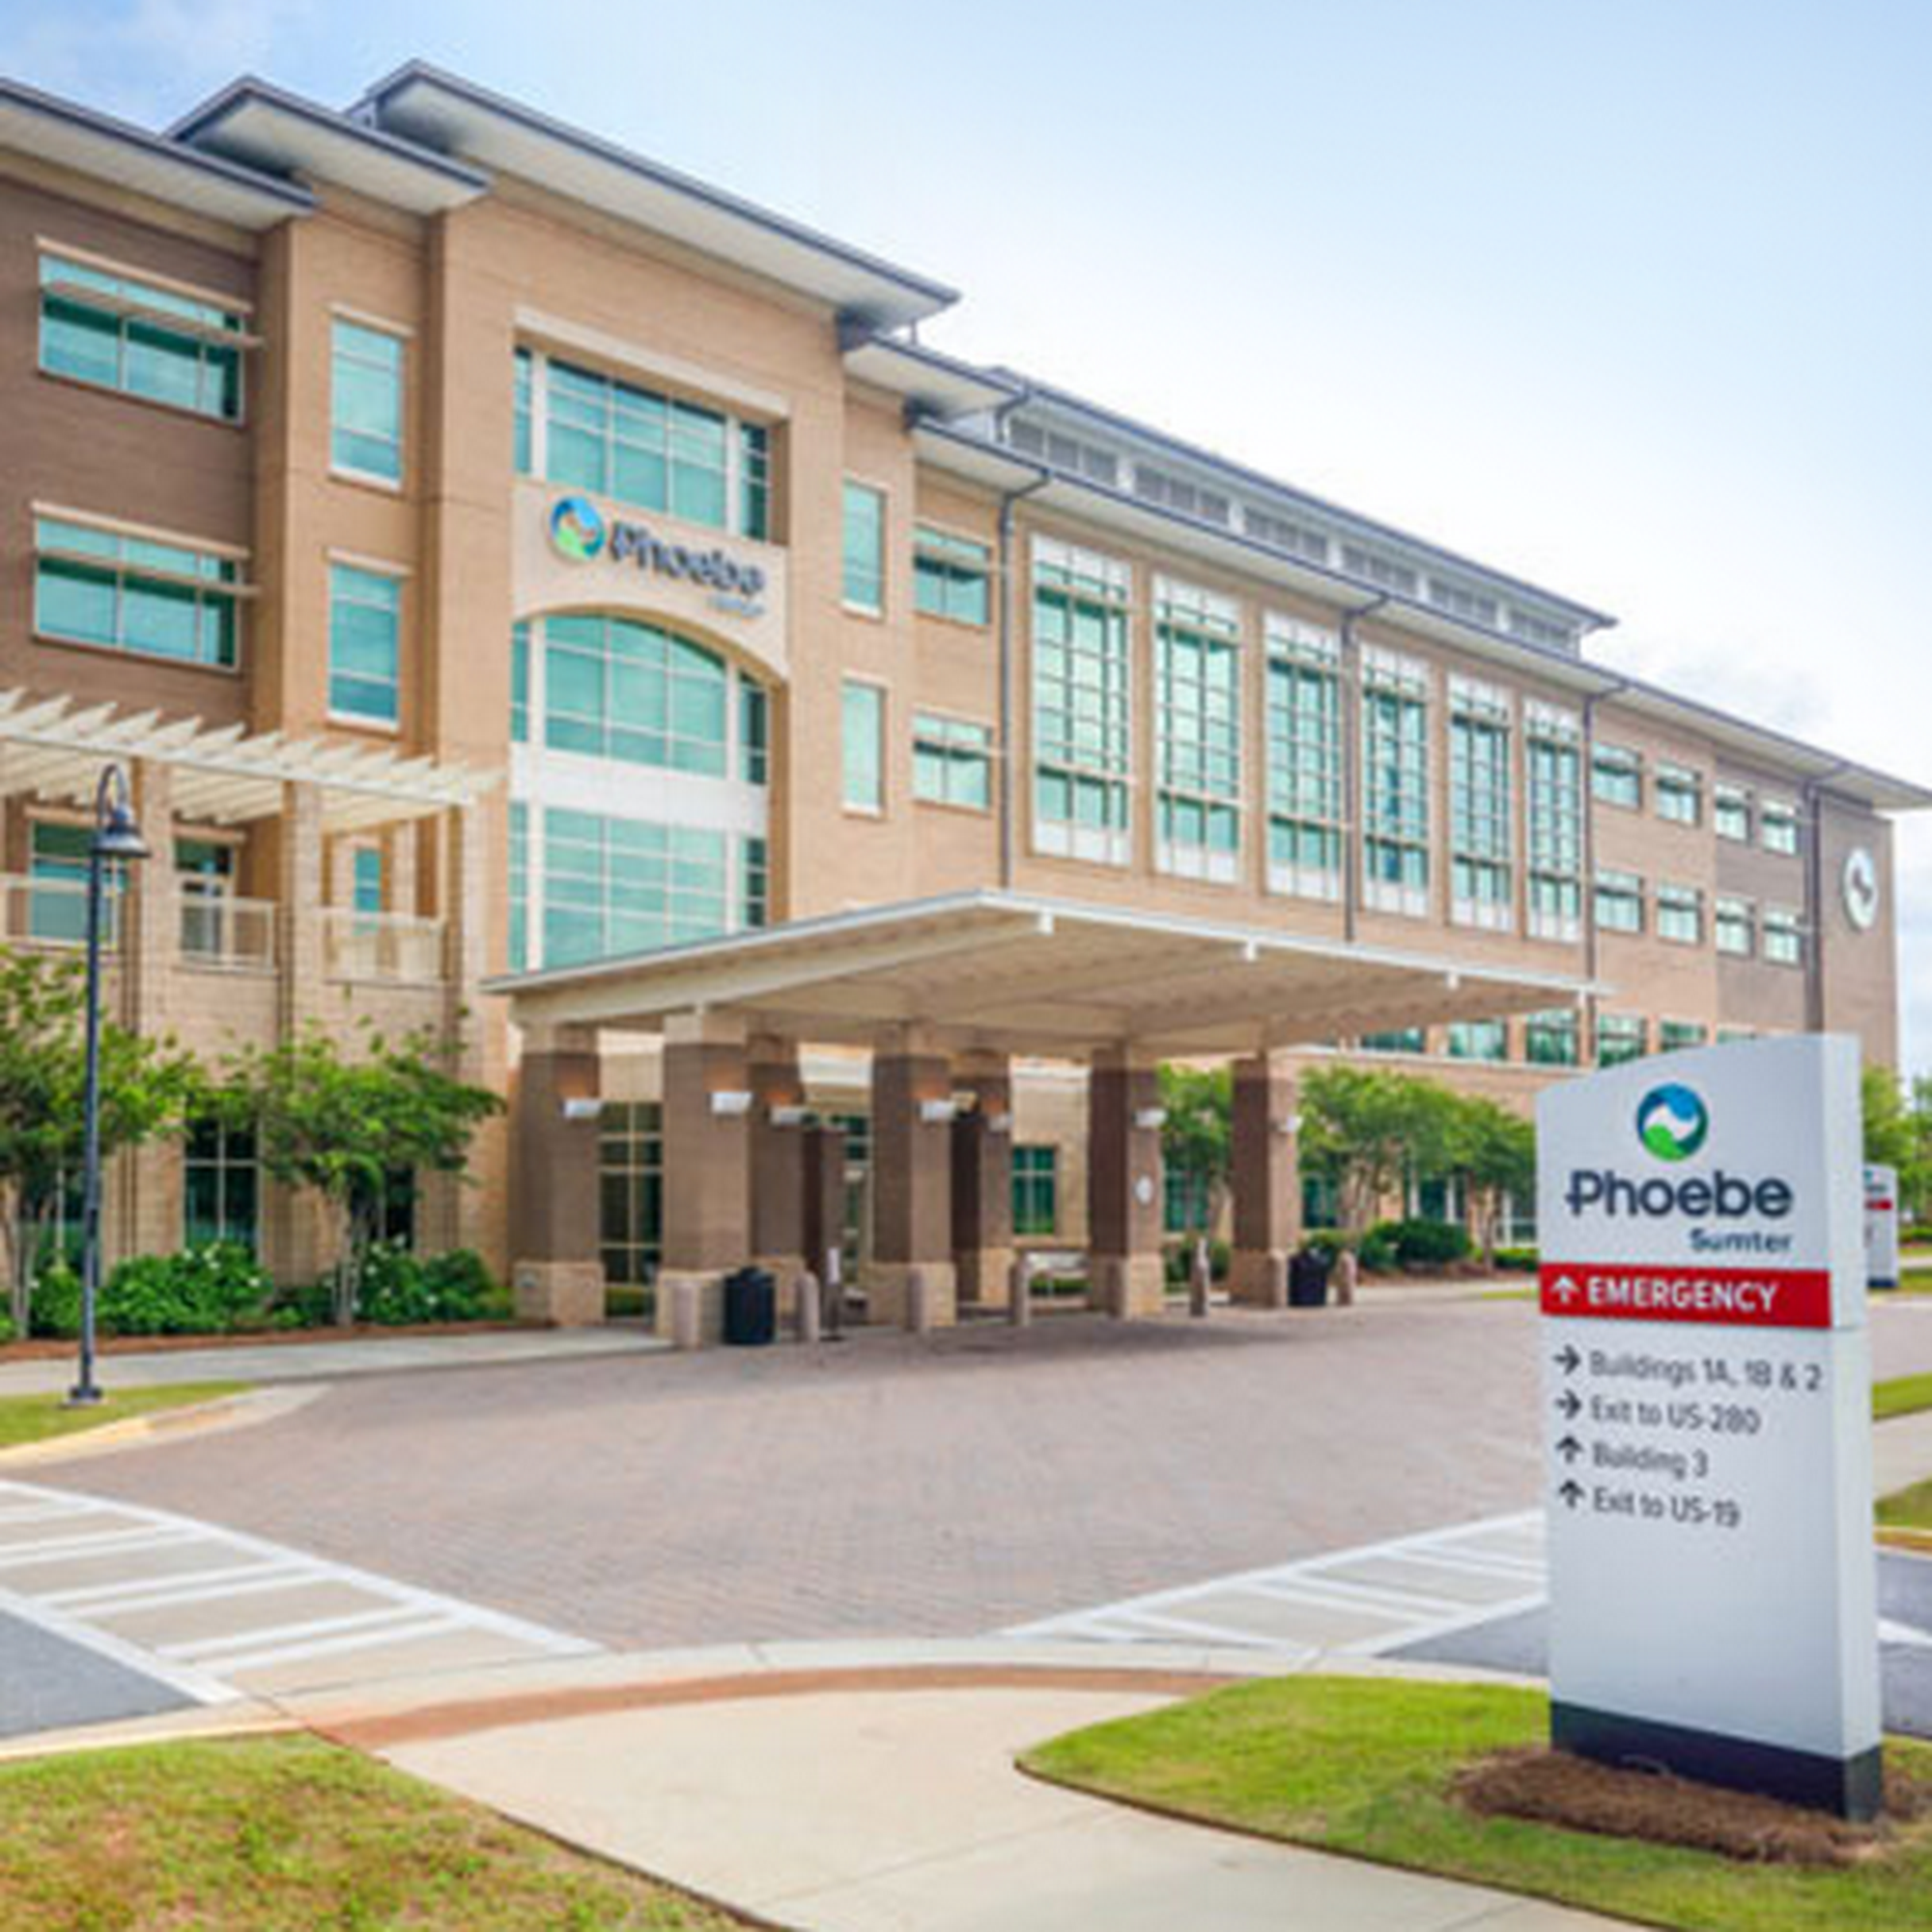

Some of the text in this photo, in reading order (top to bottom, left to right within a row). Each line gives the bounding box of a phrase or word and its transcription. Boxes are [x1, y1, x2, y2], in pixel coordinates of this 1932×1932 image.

[1566, 1170, 1793, 1218] Phoebe
[1690, 1228, 1792, 1253] Sumter
[1587, 1276, 1778, 1311] EMERGENCY
[1589, 1350, 1696, 1388] Buildings
[1779, 1363, 1797, 1389] &
[1804, 1363, 1823, 1391] 2
[1591, 1395, 1762, 1435] Exit to US-280
[1593, 1441, 1709, 1481] Building 3
[1594, 1486, 1742, 1528] Exit to US-19
